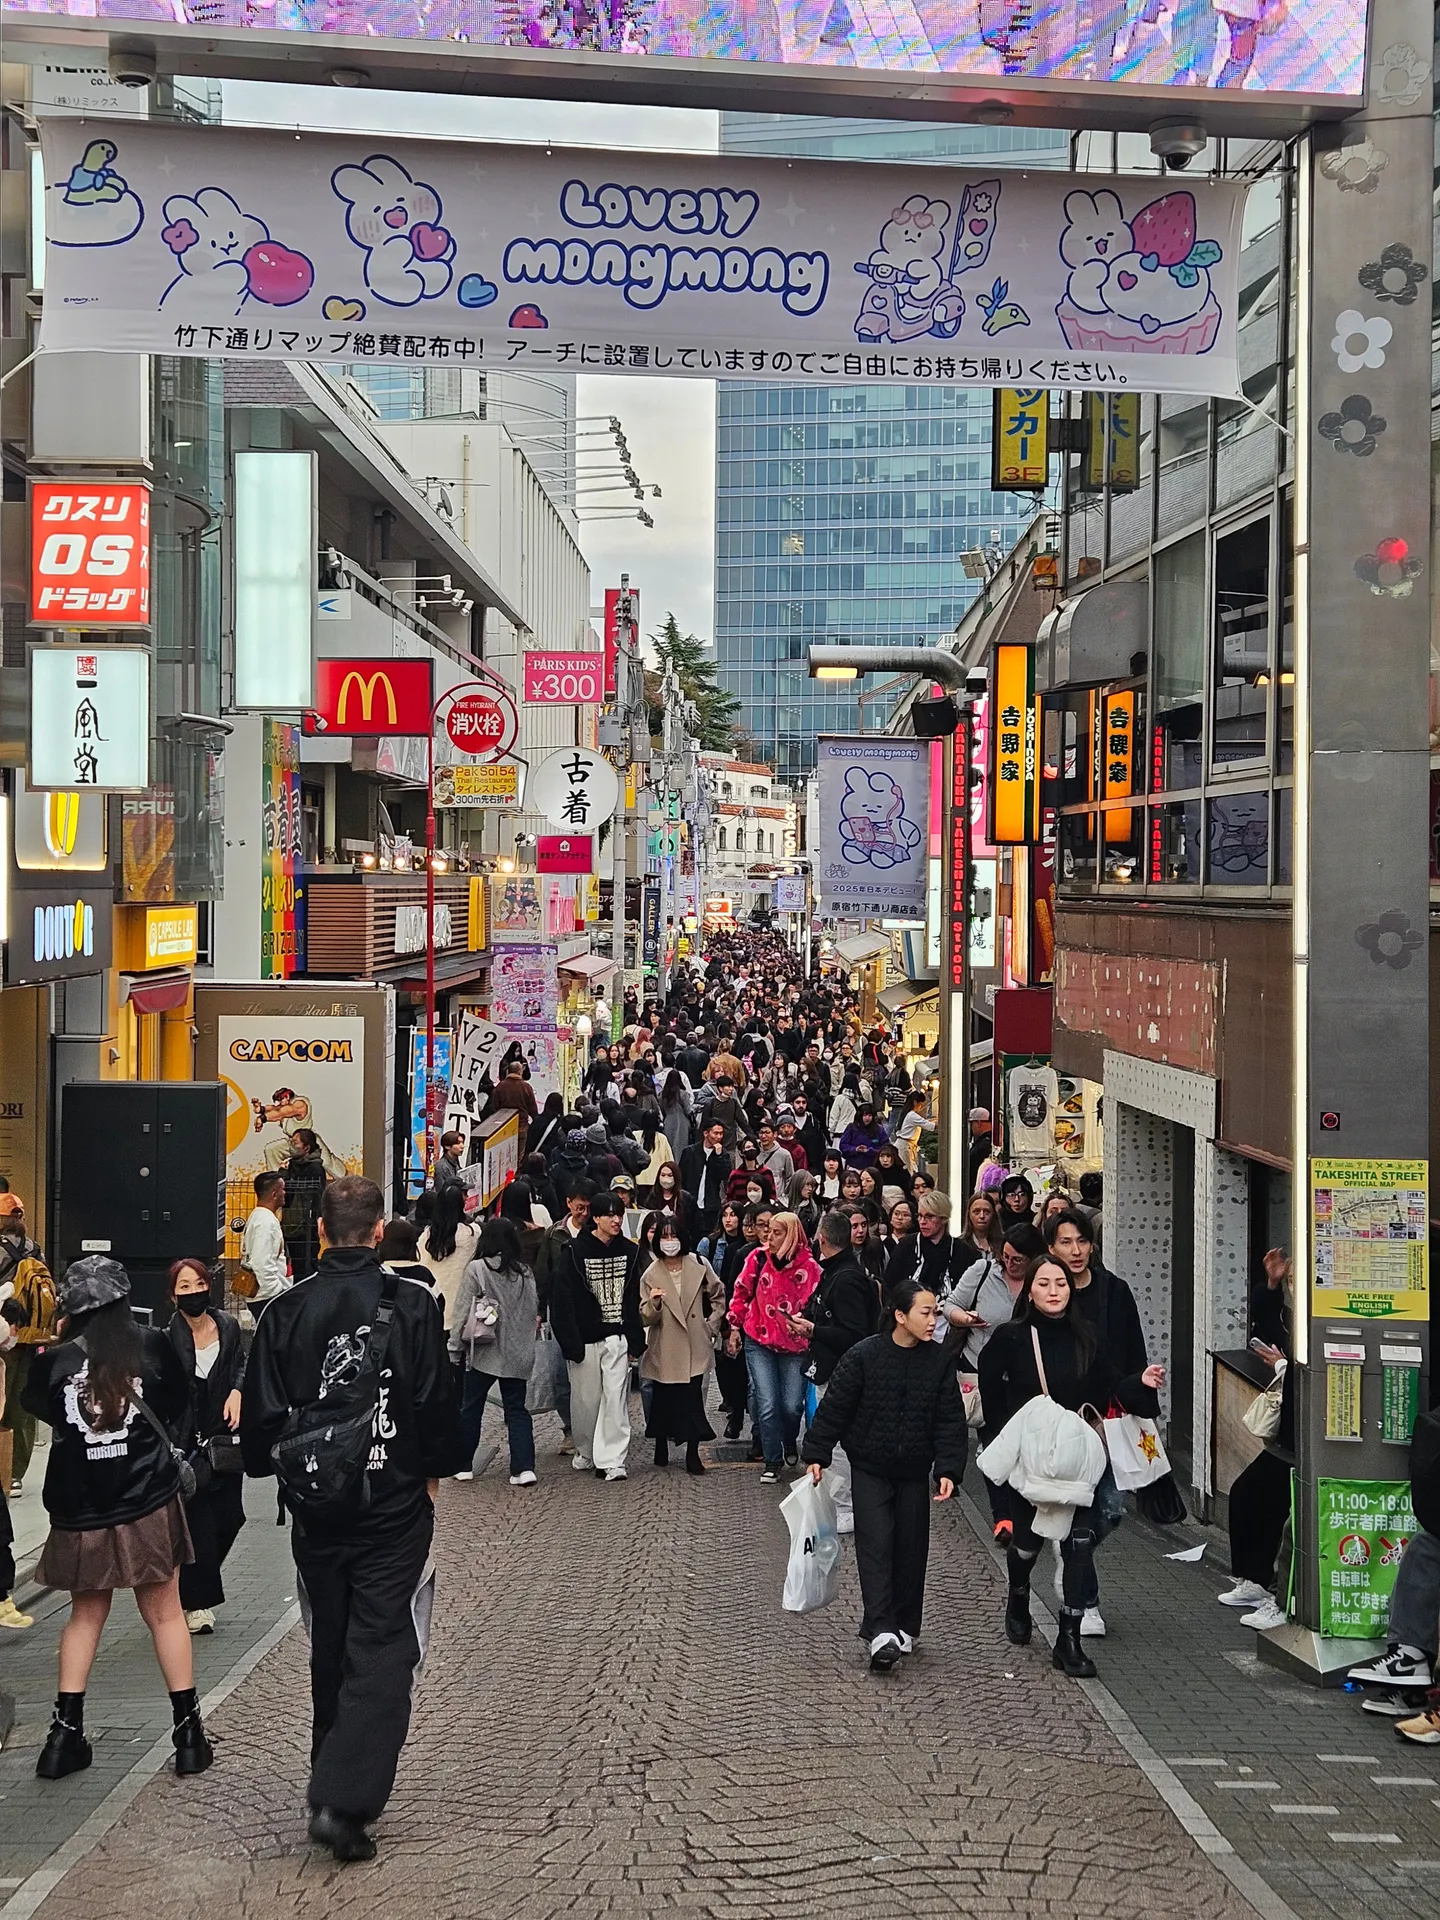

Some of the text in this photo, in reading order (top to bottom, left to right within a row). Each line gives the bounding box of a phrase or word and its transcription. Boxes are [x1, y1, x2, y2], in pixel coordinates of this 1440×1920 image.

[503, 237, 830, 317] mongmong
[174, 323, 485, 360] 竹下通りマップ絶賛配布中!
[506, 339, 1129, 384] アーチに設置していますのでご自由にお持ち帰りください。
[1004, 467, 1042, 482] 3F
[42, 496, 131, 521] クスリ
[39, 534, 134, 576] OS
[38, 587, 136, 610] ドラッグ
[533, 657, 596, 671] PARIS KID'S
[532, 674, 595, 700] ¥300
[74, 679, 110, 784] 一風堂
[451, 712, 502, 736] 消火栓
[1001, 706, 1022, 782] 吉野家
[456, 794, 505, 804] 300m先右折
[457, 785, 516, 794] タイレストラン
[561, 752, 594, 826] 古着
[953, 817, 964, 911] TAKESHITA
[833, 885, 917, 895] 2025年日本デビュー!
[648, 898, 657, 936] GALLERY
[831, 902, 919, 914] 原宿竹下通り商店会
[158, 919, 193, 939] CAPSULE LAB
[262, 930, 304, 958] GRIZZLY
[330, 1003, 358, 1016] 原宿
[230, 1038, 353, 1063] CAPCOM
[1315, 1170, 1425, 1182] TAKESHITA STREET
[87, 1443, 128, 1460] KUROMI
[1330, 1511, 1418, 1532] 歩行者用道路
[1331, 1570, 1371, 1588] 自転車は
[1331, 1611, 1361, 1624] 渋谷区
